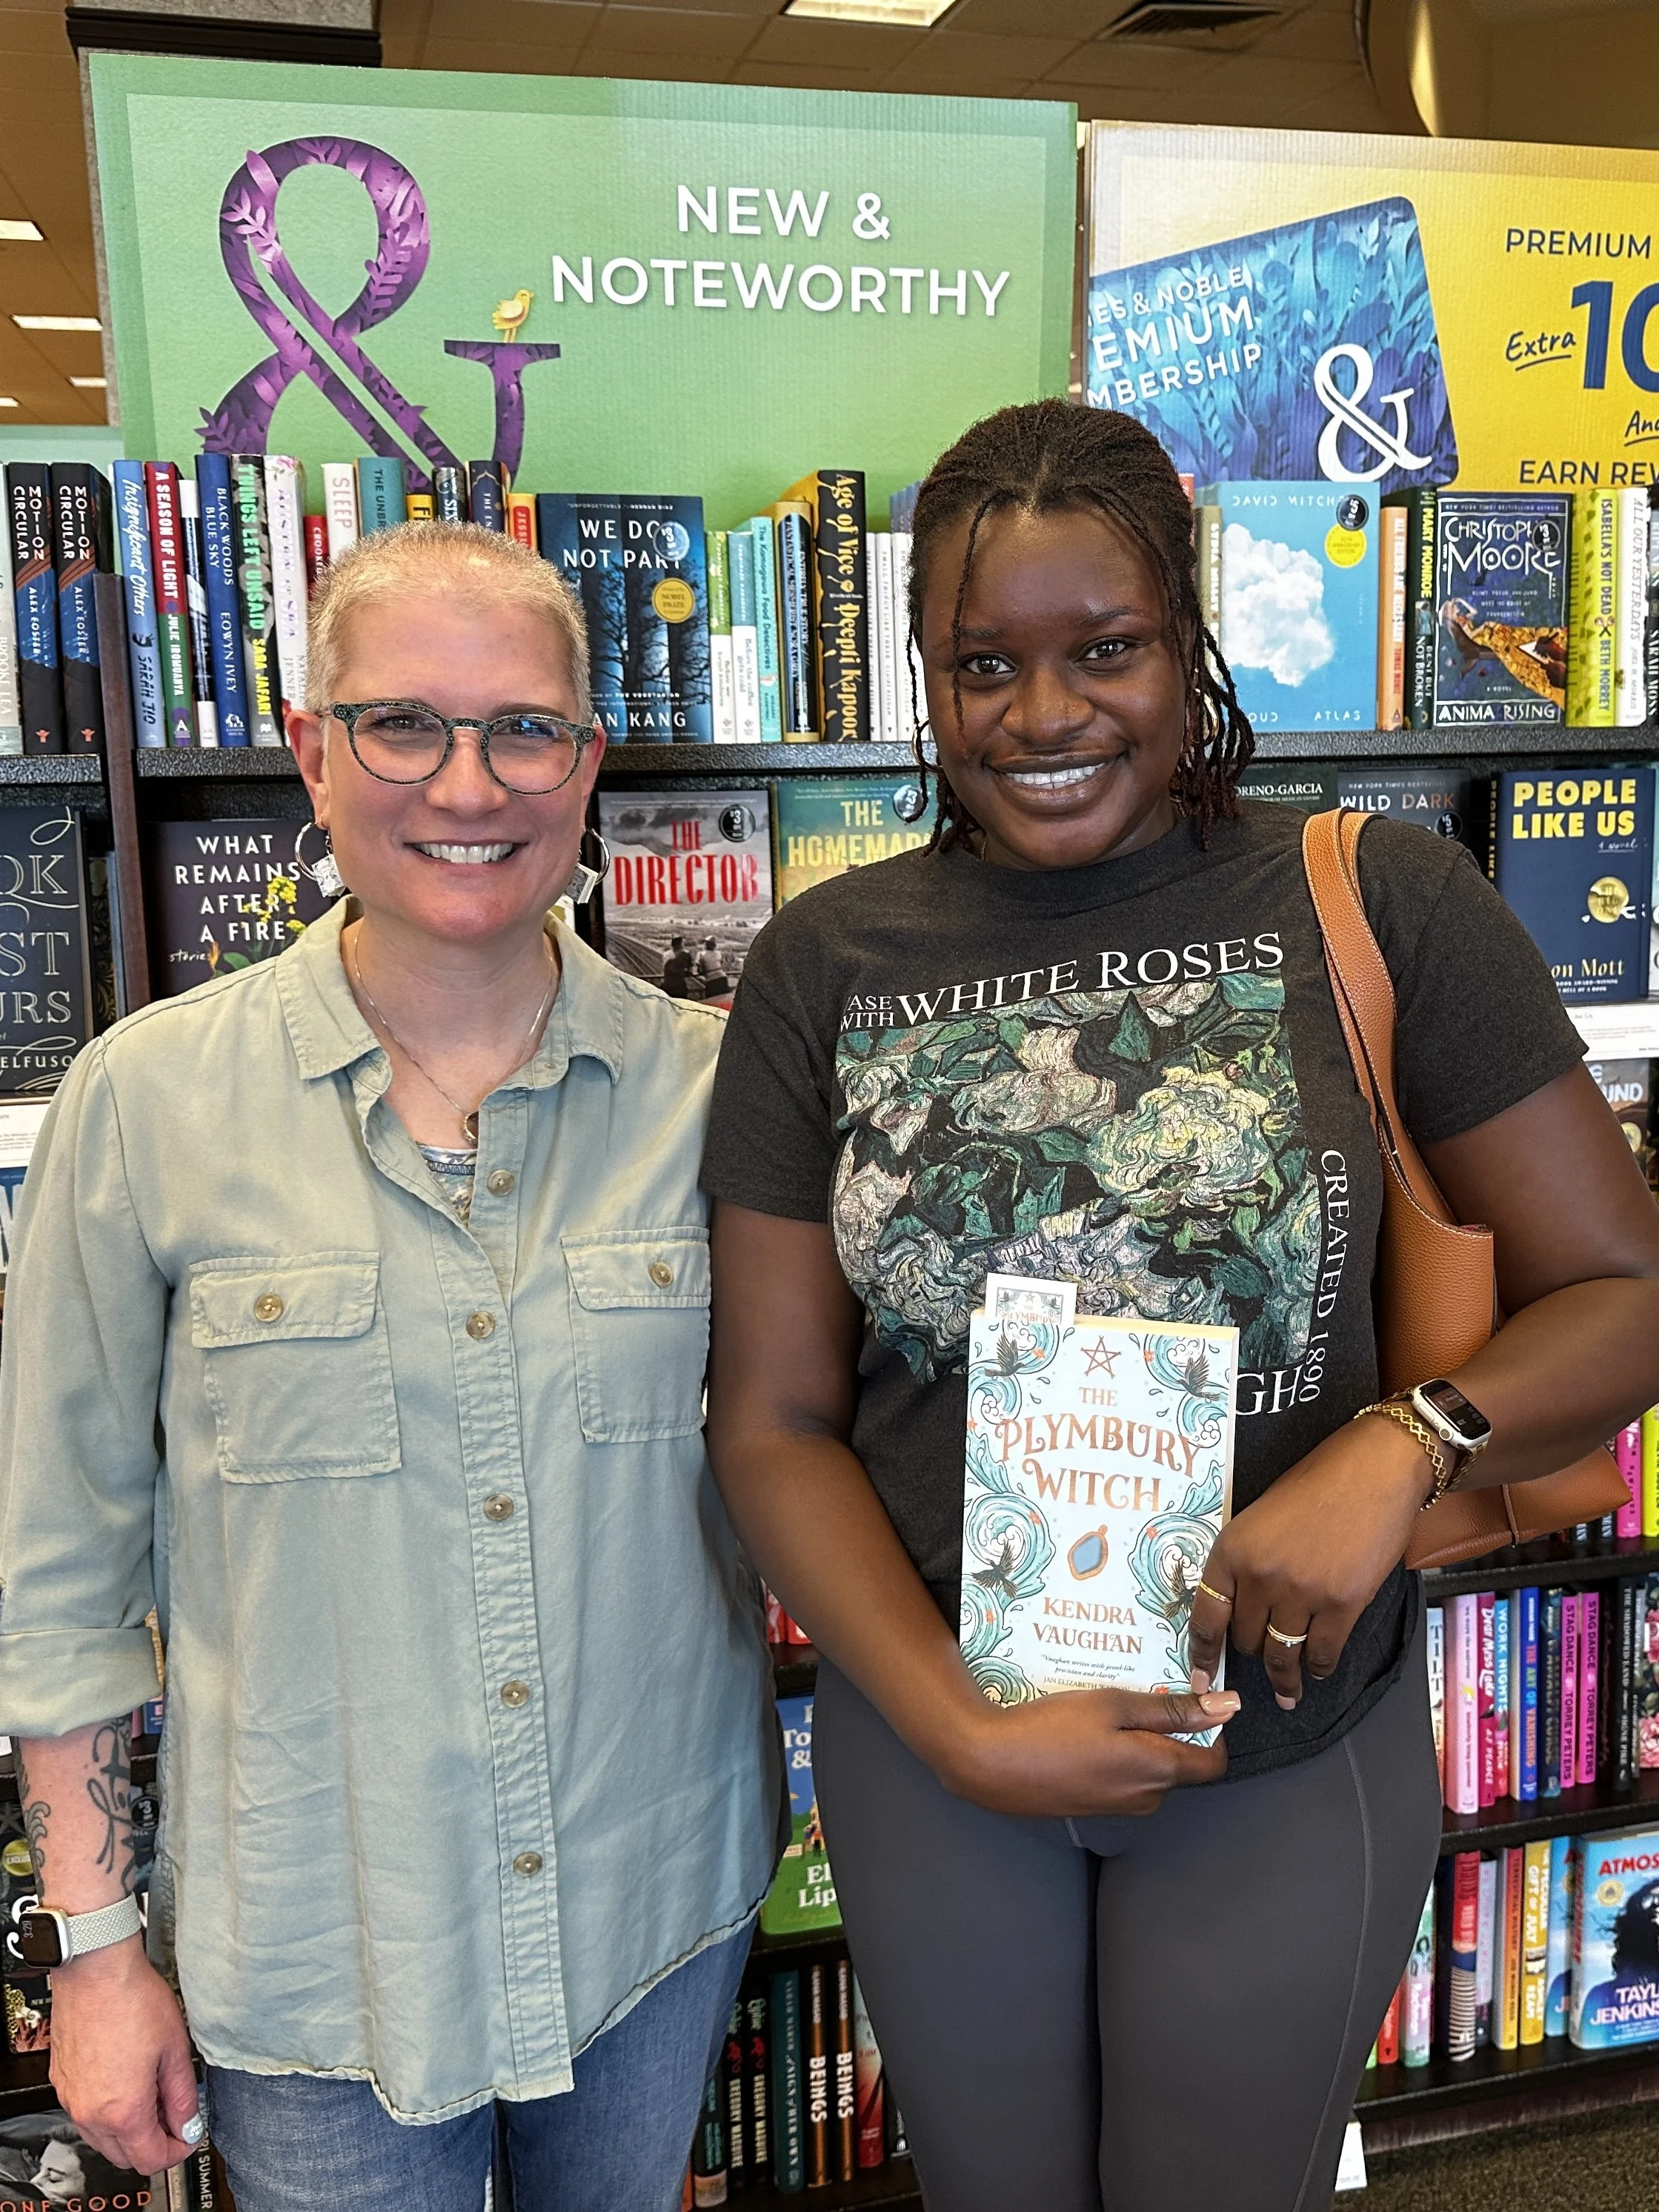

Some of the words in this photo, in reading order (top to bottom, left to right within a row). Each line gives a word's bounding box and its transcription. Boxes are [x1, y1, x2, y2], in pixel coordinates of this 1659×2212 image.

[676, 184, 830, 239] NEW
[851, 191, 893, 241] &
[1506, 228, 1652, 259] PREMIUM
[549, 254, 1011, 318] NOTEWORTHY
[1133, 292, 1151, 315] &
[1157, 266, 1245, 308] NOBLE
[1092, 296, 1254, 371] EMIUM
[1506, 331, 1577, 363] Extra
[1087, 342, 1261, 408] MBERSHIP
[154, 471, 170, 480] A
[374, 468, 384, 491] THE
[1519, 459, 1600, 485] EARN
[237, 464, 258, 523] THINGS
[331, 477, 352, 528] SLEEP
[483, 492, 492, 511] THE
[828, 474, 857, 509] Age
[1232, 495, 1277, 507] DAVID
[1289, 494, 1344, 507] MITCH
[13, 485, 29, 559] CIRCULAR
[29, 485, 45, 560] MOTION
[59, 485, 75, 559] CIRCULAR
[75, 485, 90, 560] MOTION
[156, 484, 173, 536] SEASON
[205, 506, 218, 539] BLUE
[216, 487, 230, 531] BLACK
[831, 514, 859, 534] of
[1422, 508, 1434, 542] MARY
[1633, 497, 1643, 525] ALL
[122, 479, 148, 574] Insignificant
[579, 519, 616, 539] WE
[628, 519, 661, 539] DO
[1445, 517, 1532, 548] CHRISTOPH
[1632, 528, 1643, 555] OUR
[160, 539, 175, 557] OF
[209, 544, 220, 568] SKY
[222, 534, 234, 585] WOODS
[242, 528, 261, 565] LEFT
[563, 548, 611, 568] NOT
[827, 539, 859, 575] Vice
[162, 559, 178, 599] LIGHT
[1420, 545, 1433, 599] MONROE
[1600, 562, 1612, 582] NOT
[28, 586, 39, 613] ALEX
[74, 586, 84, 612] ALEX
[130, 574, 149, 617] Others
[245, 569, 267, 630] UNSAID
[762, 597, 771, 620] Food
[1600, 586, 1612, 615] DEAD
[1630, 558, 1643, 641] YESTERDAYS
[30, 617, 41, 654] FOSTER
[76, 617, 88, 654] FOSTER
[168, 614, 180, 640] JULIE
[220, 612, 233, 660] EOWYN
[830, 602, 861, 664] Deepti
[252, 638, 267, 670] SARA
[763, 622, 771, 669] Detectives
[1415, 636, 1426, 660] NOT
[1600, 640, 1611, 665] BETH
[138, 656, 154, 698] SARAH
[225, 664, 237, 693] IVEY
[284, 657, 296, 700] JENNER
[1414, 662, 1425, 707] BROKEN
[1425, 677, 1433, 697] BUT
[255, 673, 271, 715] JAFARI
[831, 668, 862, 741] Kapoor
[1647, 680, 1659, 716] MOSS
[142, 702, 156, 725] JIO
[594, 712, 618, 728] AN
[630, 711, 686, 728] KANG
[1314, 711, 1362, 722] ATLAS
[1439, 705, 1495, 721] ANIMA
[1503, 703, 1555, 720] RISING
[1235, 783, 1323, 797] ORENO-GARCIA
[1340, 794, 1391, 811] WILD
[1401, 793, 1456, 809] DARK
[1513, 779, 1637, 807] PEOPLE
[840, 800, 884, 827] THE
[1512, 812, 1584, 839] LIKE
[1597, 810, 1635, 837] US
[196, 834, 273, 854] WHAT
[670, 820, 702, 851] THE
[788, 832, 932, 867] HOMEMAD
[175, 862, 301, 885] REMAINS
[614, 854, 759, 906] DIRECTOR
[200, 894, 280, 914] AFTER
[200, 924, 215, 943] A
[228, 921, 286, 942] FIRE
[169, 949, 212, 963] storie
[1581, 958, 1625, 977] Mott
[896, 961, 1080, 1026] WHITE
[1097, 931, 1286, 990] ROSES
[840, 1012, 894, 1033] WITH
[0, 1055, 73, 1069] ELFUSO
[1317, 1149, 1350, 1318] CREATED
[1298, 1330, 1329, 1404] 1890
[1079, 1386, 1118, 1407] THE
[1235, 1364, 1303, 1416] GH
[994, 1412, 1202, 1478] PLYMBURY
[1022, 1458, 1162, 1512] WITCH
[1043, 1596, 1137, 1626] KENDRA
[1481, 1607, 1495, 1639] Dear
[1566, 1604, 1575, 1633] STAG
[1587, 1601, 1597, 1629] STAG
[1032, 1622, 1143, 1655] VAUGHAN
[1497, 1608, 1508, 1653] WORK
[1091, 1661, 1106, 1669] with
[1430, 1624, 1443, 1691] TILT
[1526, 1644, 1537, 1664] THE
[1565, 1635, 1575, 1673] DANCE
[1587, 1631, 1596, 1670] DANCE
[1054, 1667, 1081, 1675] precision
[1058, 1678, 1097, 1690] ELIZABETH
[1479, 1669, 1495, 1696] Lake
[1497, 1658, 1508, 1713] NIGHTS
[1526, 1668, 1537, 1687] ART
[1525, 1690, 1537, 1706] OF
[1563, 1693, 1574, 1735] TORREY
[1586, 1688, 1595, 1731] TORREY
[1525, 1708, 1537, 1768] VANISHING
[791, 1750, 812, 1770] &
[1563, 1737, 1573, 1780] PETERS
[1585, 1733, 1595, 1776] PETERS
[1528, 1865, 1539, 1894] GIFT
[1598, 1854, 1659, 1876] ATMOS
[799, 1887, 837, 1908] Lip
[1526, 1914, 1537, 1943] JULY
[1616, 1983, 1659, 2002] TAYL
[809, 2056, 828, 2123] BEINGS
[837, 2051, 854, 2119] BEINGS
[199, 2154, 213, 2210] SUMMER
[67, 2191, 153, 2212] GOOD
